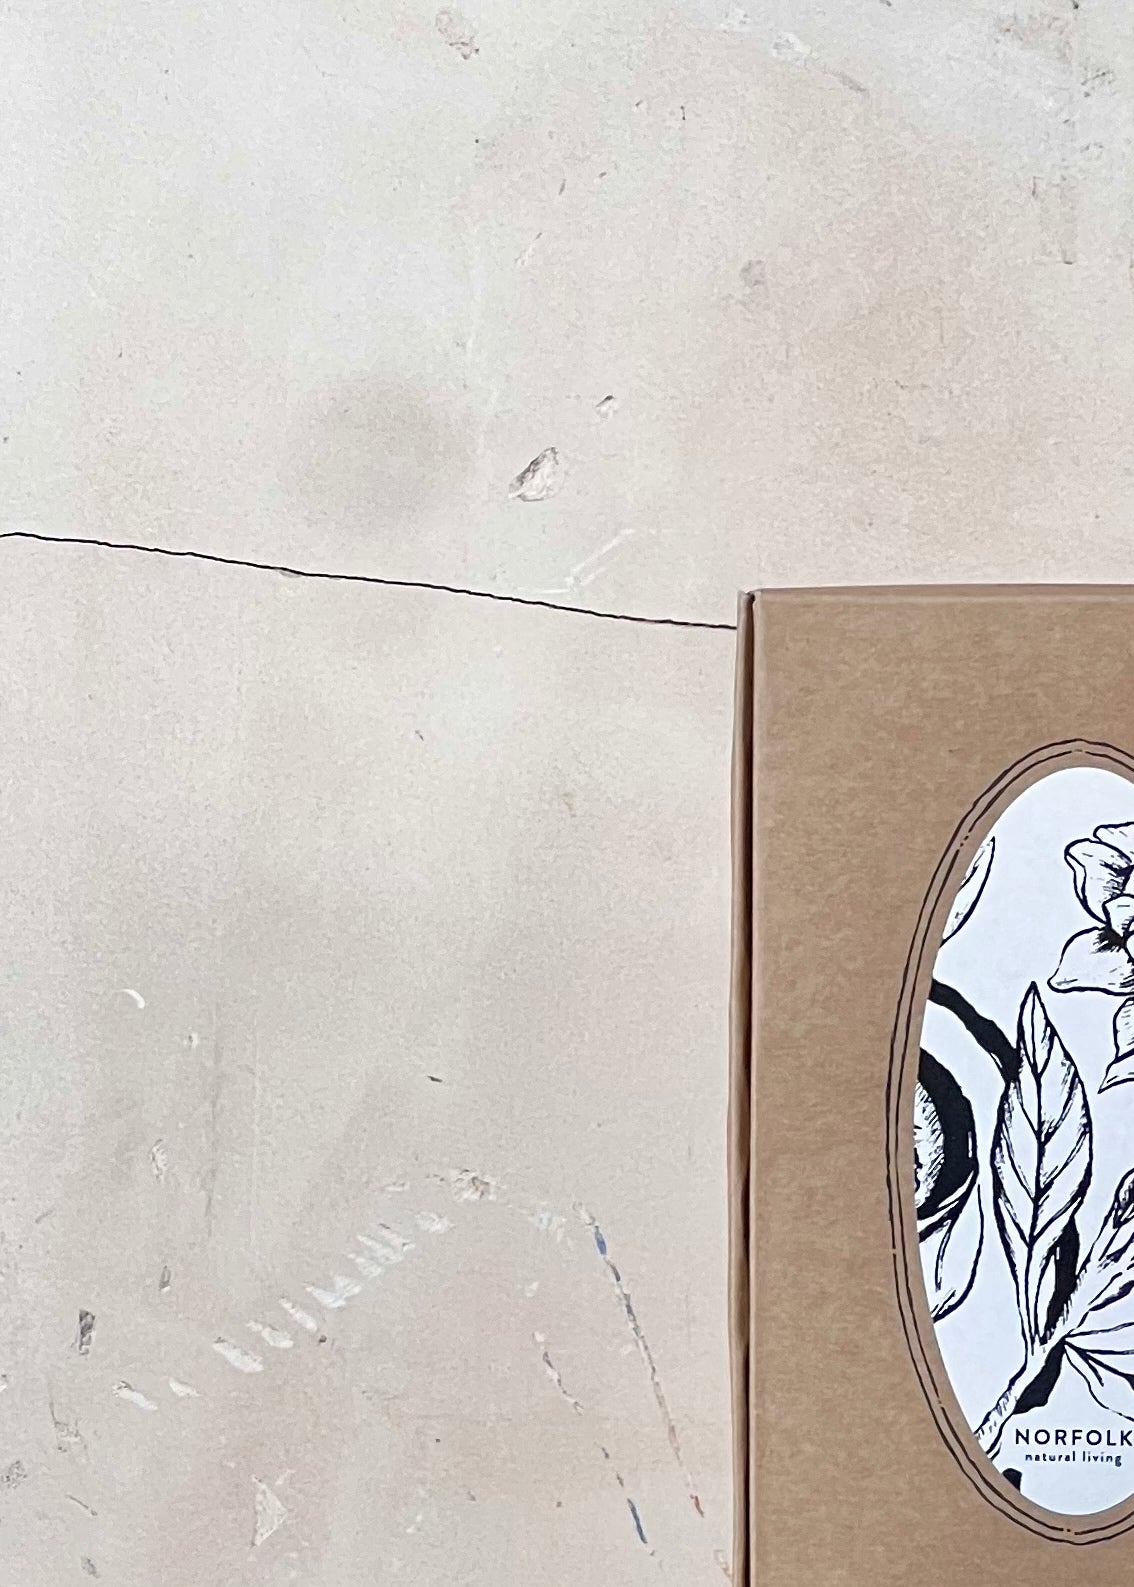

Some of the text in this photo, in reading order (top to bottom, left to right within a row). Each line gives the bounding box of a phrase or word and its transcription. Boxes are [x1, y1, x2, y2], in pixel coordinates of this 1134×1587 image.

[1014, 1428, 1133, 1447] NORFOLK
[1024, 1451, 1122, 1467] natural living
